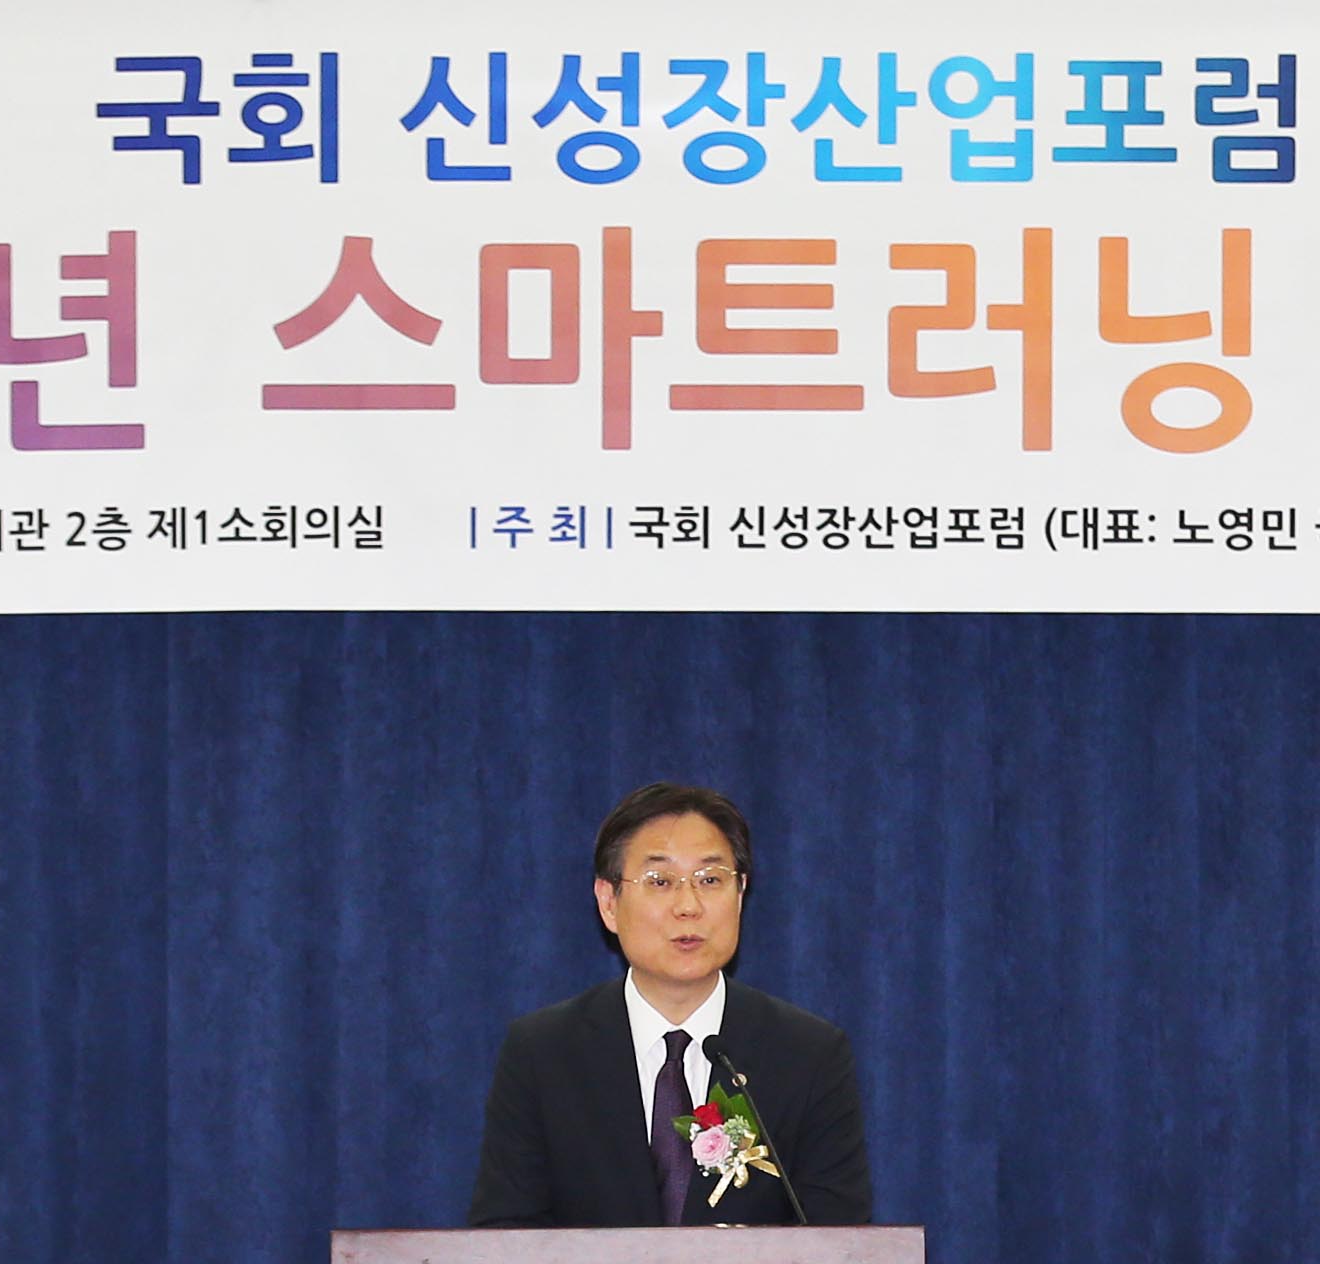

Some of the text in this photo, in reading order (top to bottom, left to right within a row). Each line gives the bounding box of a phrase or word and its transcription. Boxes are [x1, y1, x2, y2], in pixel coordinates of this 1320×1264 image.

[96, 52, 1296, 185] 국회 신성장산업포럼
[262, 227, 1252, 453] 스마트러닝
[65, 506, 133, 552] 2층
[146, 504, 384, 551] 제1소회의실
[628, 505, 710, 550] 국회
[728, 505, 1025, 551] 신성장산업포럼
[1044, 506, 1156, 552] (대표:
[1172, 507, 1298, 552] 노영민
